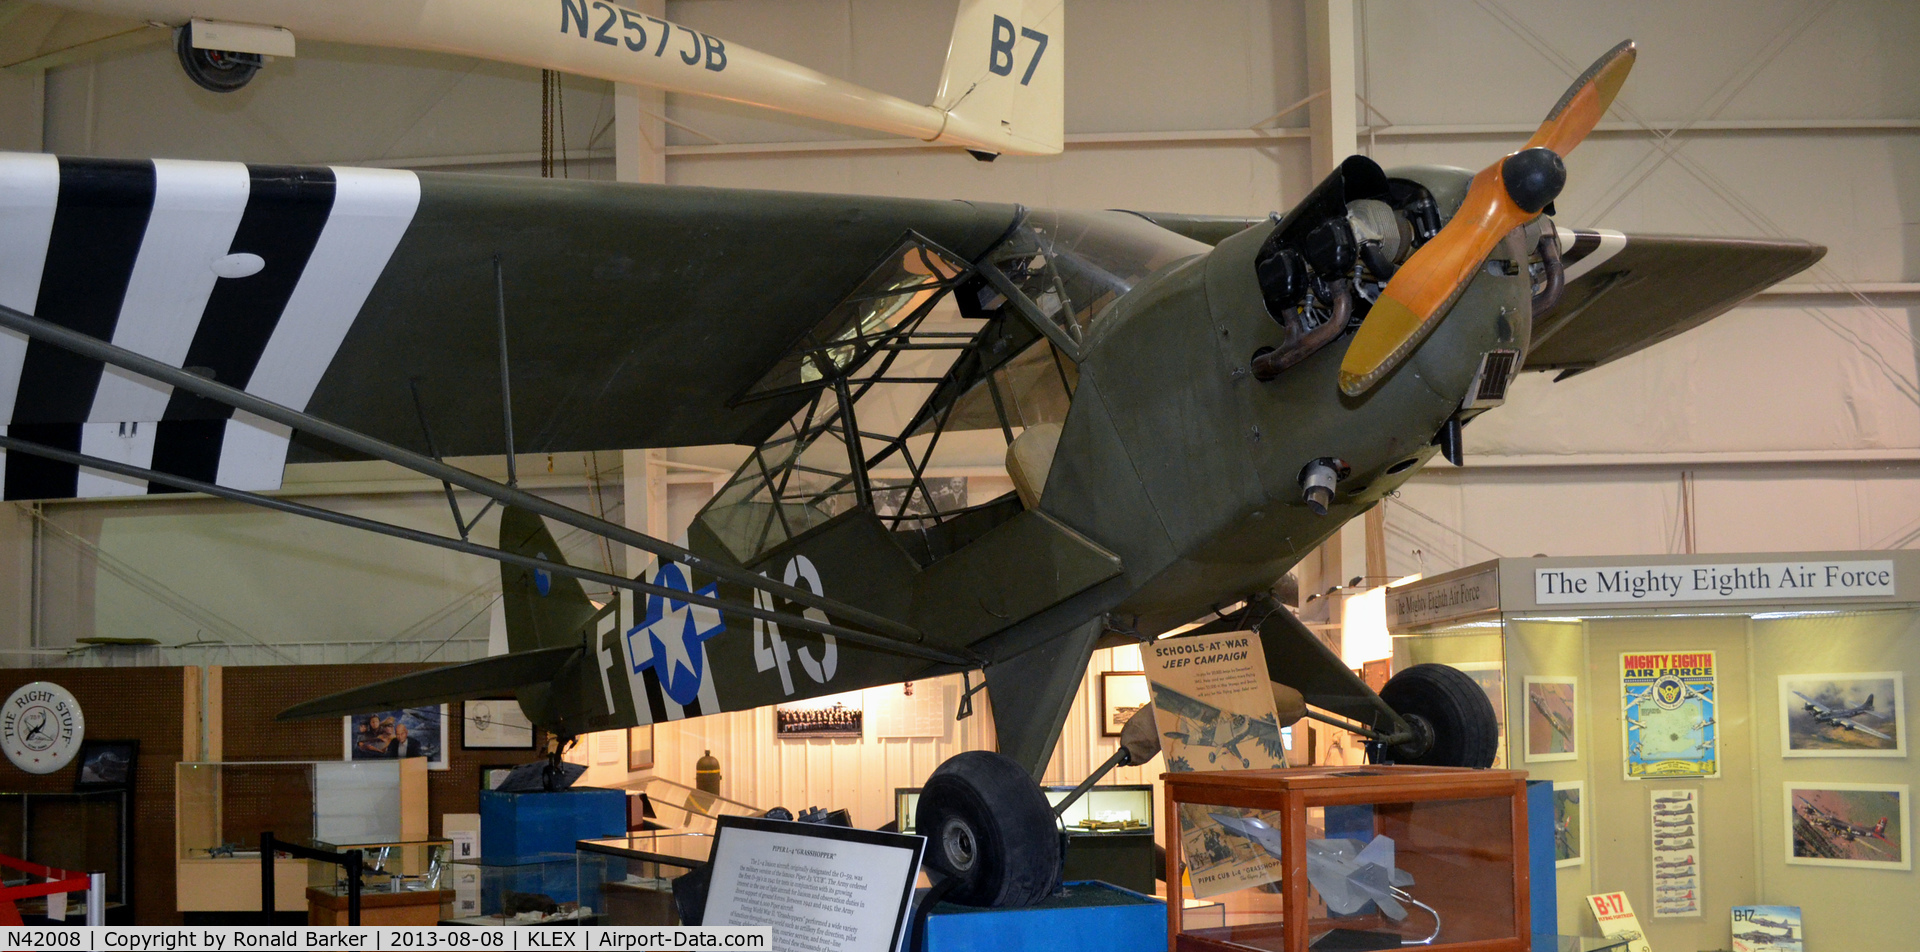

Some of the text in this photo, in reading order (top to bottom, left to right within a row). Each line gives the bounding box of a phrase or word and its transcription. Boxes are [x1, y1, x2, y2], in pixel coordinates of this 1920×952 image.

[561, 0, 727, 72] N257JB
[988, 14, 1048, 86] B7
[1541, 566, 1890, 598] The Mighty Eighth Air Force
[1395, 584, 1480, 617] The Mighty Eighth Air Force
[597, 554, 838, 716] F 43
[1162, 651, 1248, 669] JEEP CAMPAIGN
[1624, 653, 1712, 669] MIGHTY EIGHTH
[1625, 667, 1713, 678] AIR FORCE
[15, 690, 55, 708] RIGHT
[1198, 875, 1216, 884] PIPER
[1217, 871, 1230, 880] CUB
[1243, 860, 1281, 873] "GRASSHOPP
[1593, 894, 1624, 915] B-17
[1733, 909, 1755, 922] B-17
